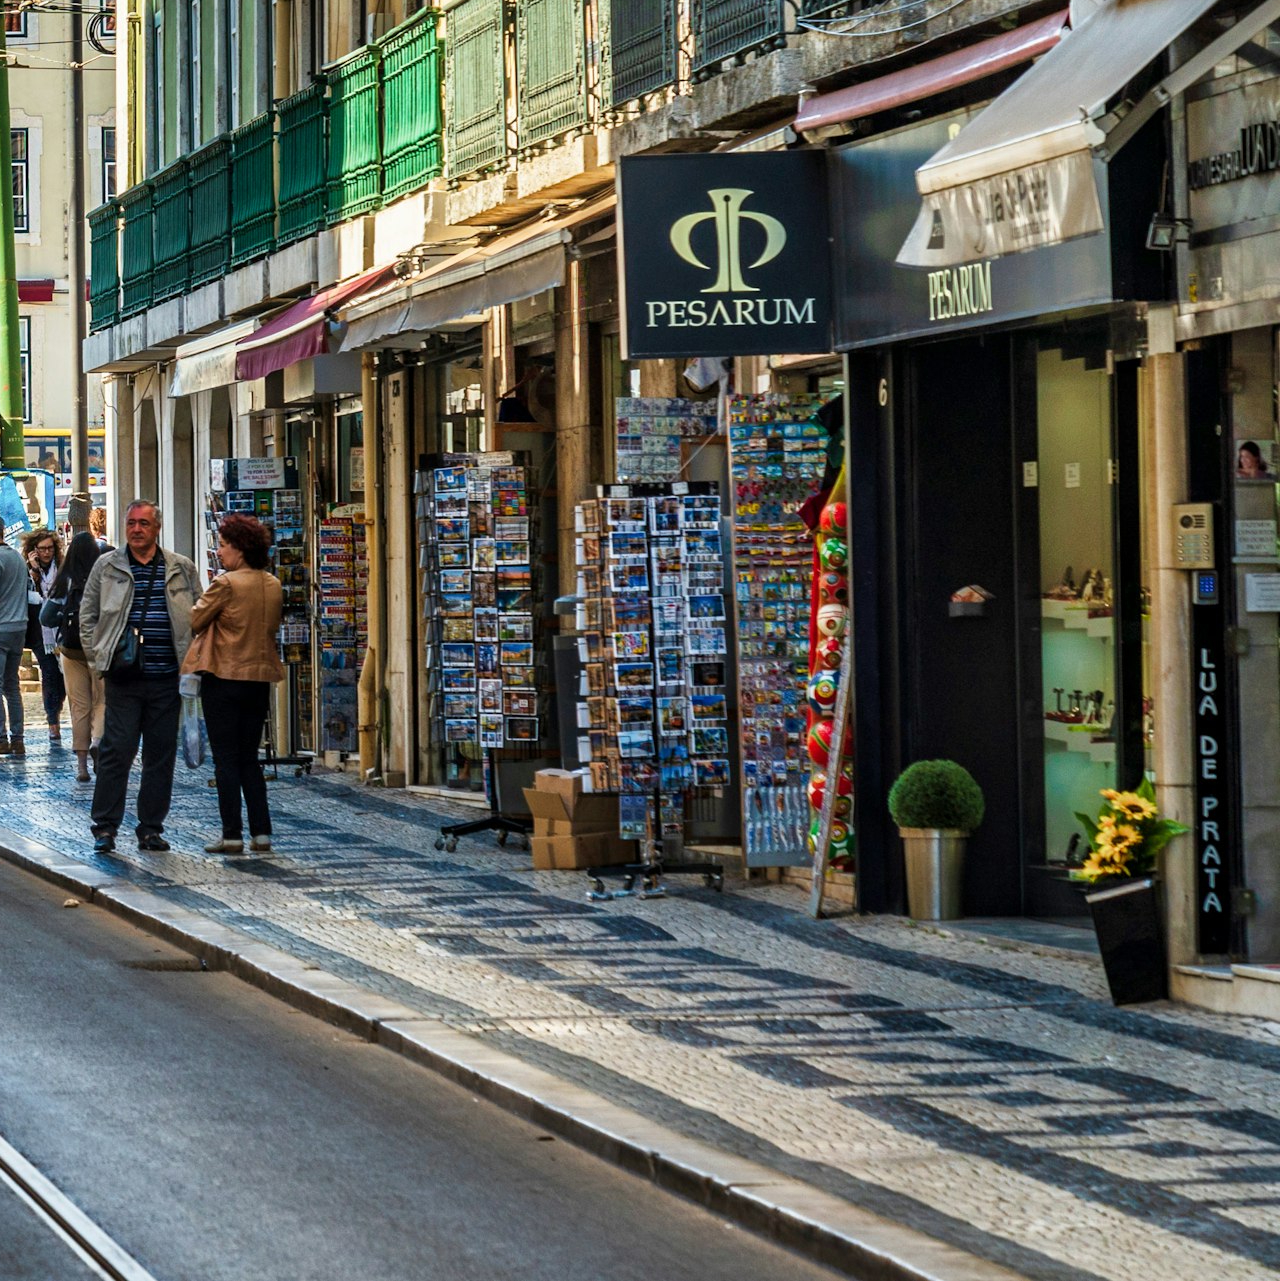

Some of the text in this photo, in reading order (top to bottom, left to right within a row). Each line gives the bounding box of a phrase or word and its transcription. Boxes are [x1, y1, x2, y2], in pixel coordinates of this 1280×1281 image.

[646, 298, 817, 328] PESARUM
[928, 262, 993, 321] PESARUM
[878, 378, 888, 406] 6
[1198, 648, 1223, 913] LUA DE PRATA
